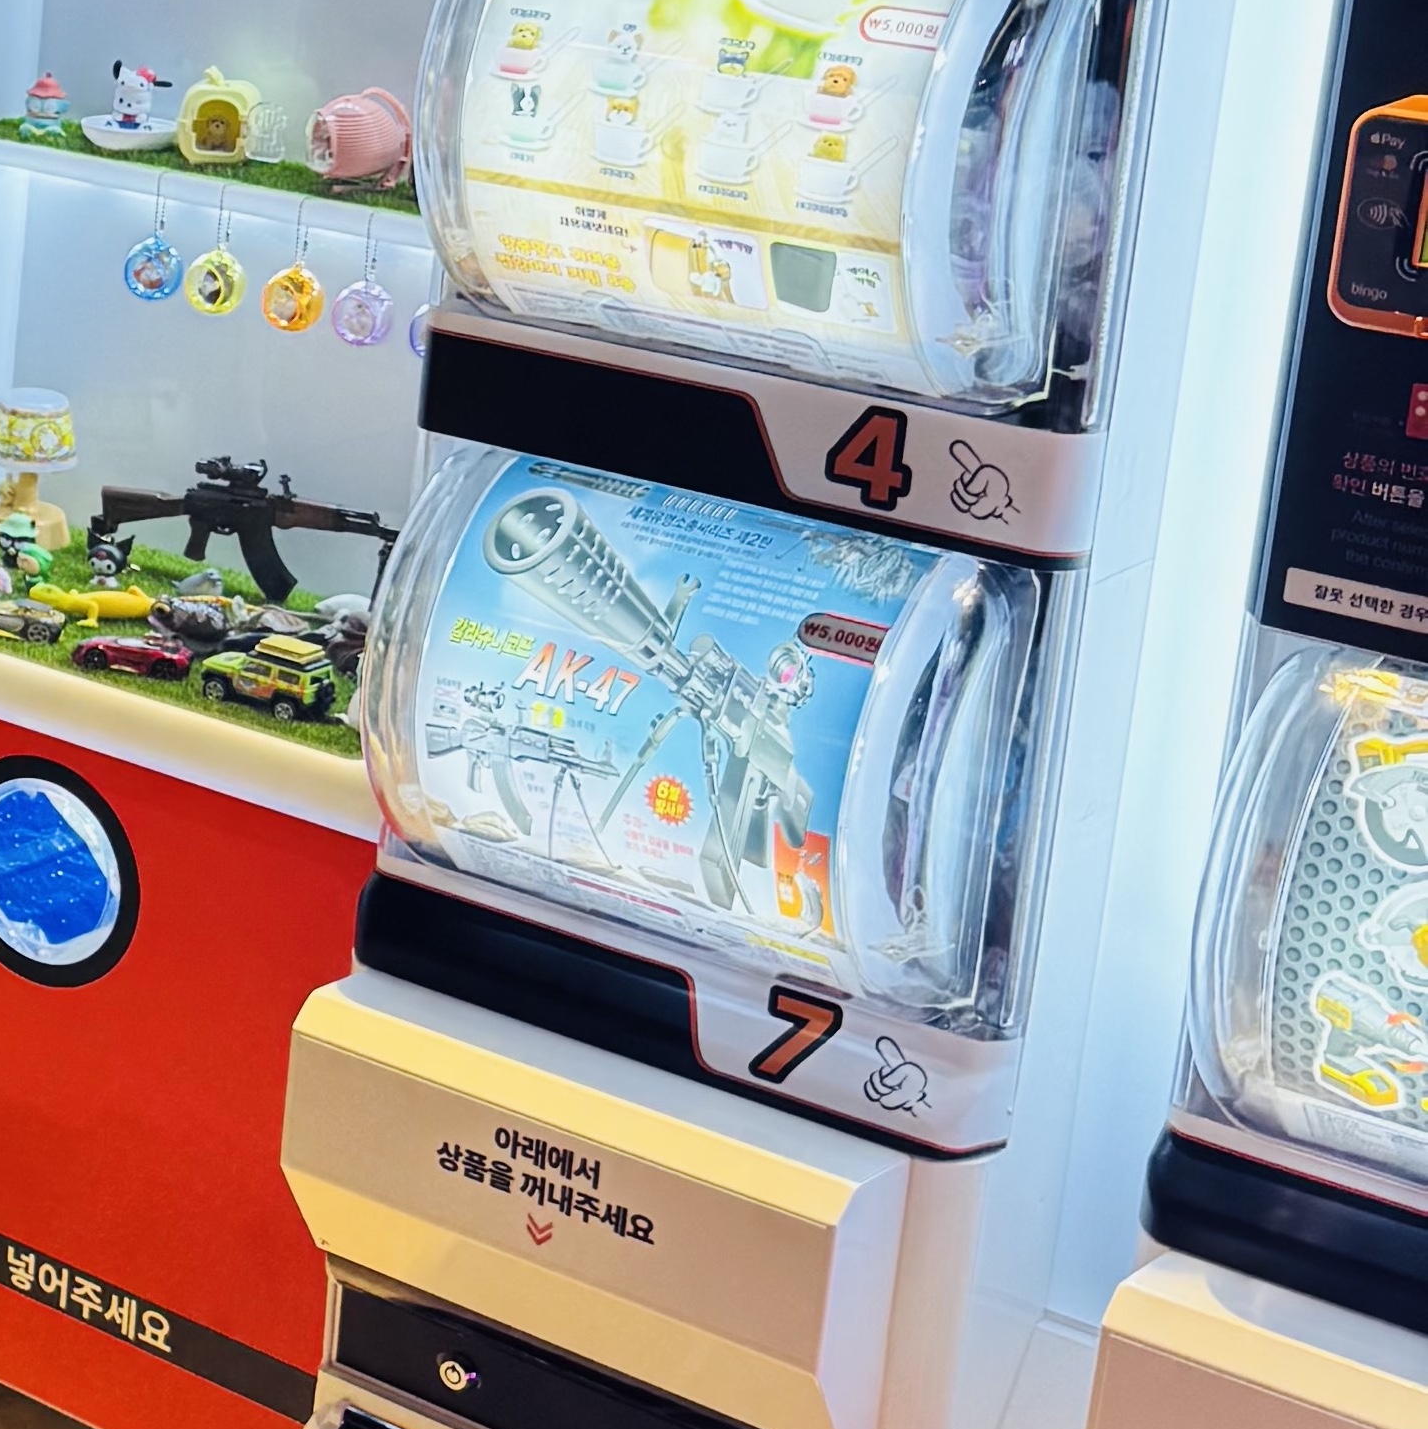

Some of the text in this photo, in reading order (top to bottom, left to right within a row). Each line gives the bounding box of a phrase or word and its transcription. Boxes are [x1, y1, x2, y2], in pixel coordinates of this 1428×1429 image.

[1381, 132, 1407, 150] Pay
[1350, 281, 1388, 302] bingo
[824, 404, 913, 512] 4
[1371, 480, 1425, 509] 버튼을
[1313, 583, 1345, 604] 잘못
[1349, 592, 1395, 615] 선택한
[511, 641, 642, 717] AK-47
[747, 984, 845, 1085] 7
[493, 1125, 603, 1189] 아래에서
[436, 1140, 656, 1246] 상품을 꺼내주세요
[6, 1243, 174, 1355] 넣어주세요
